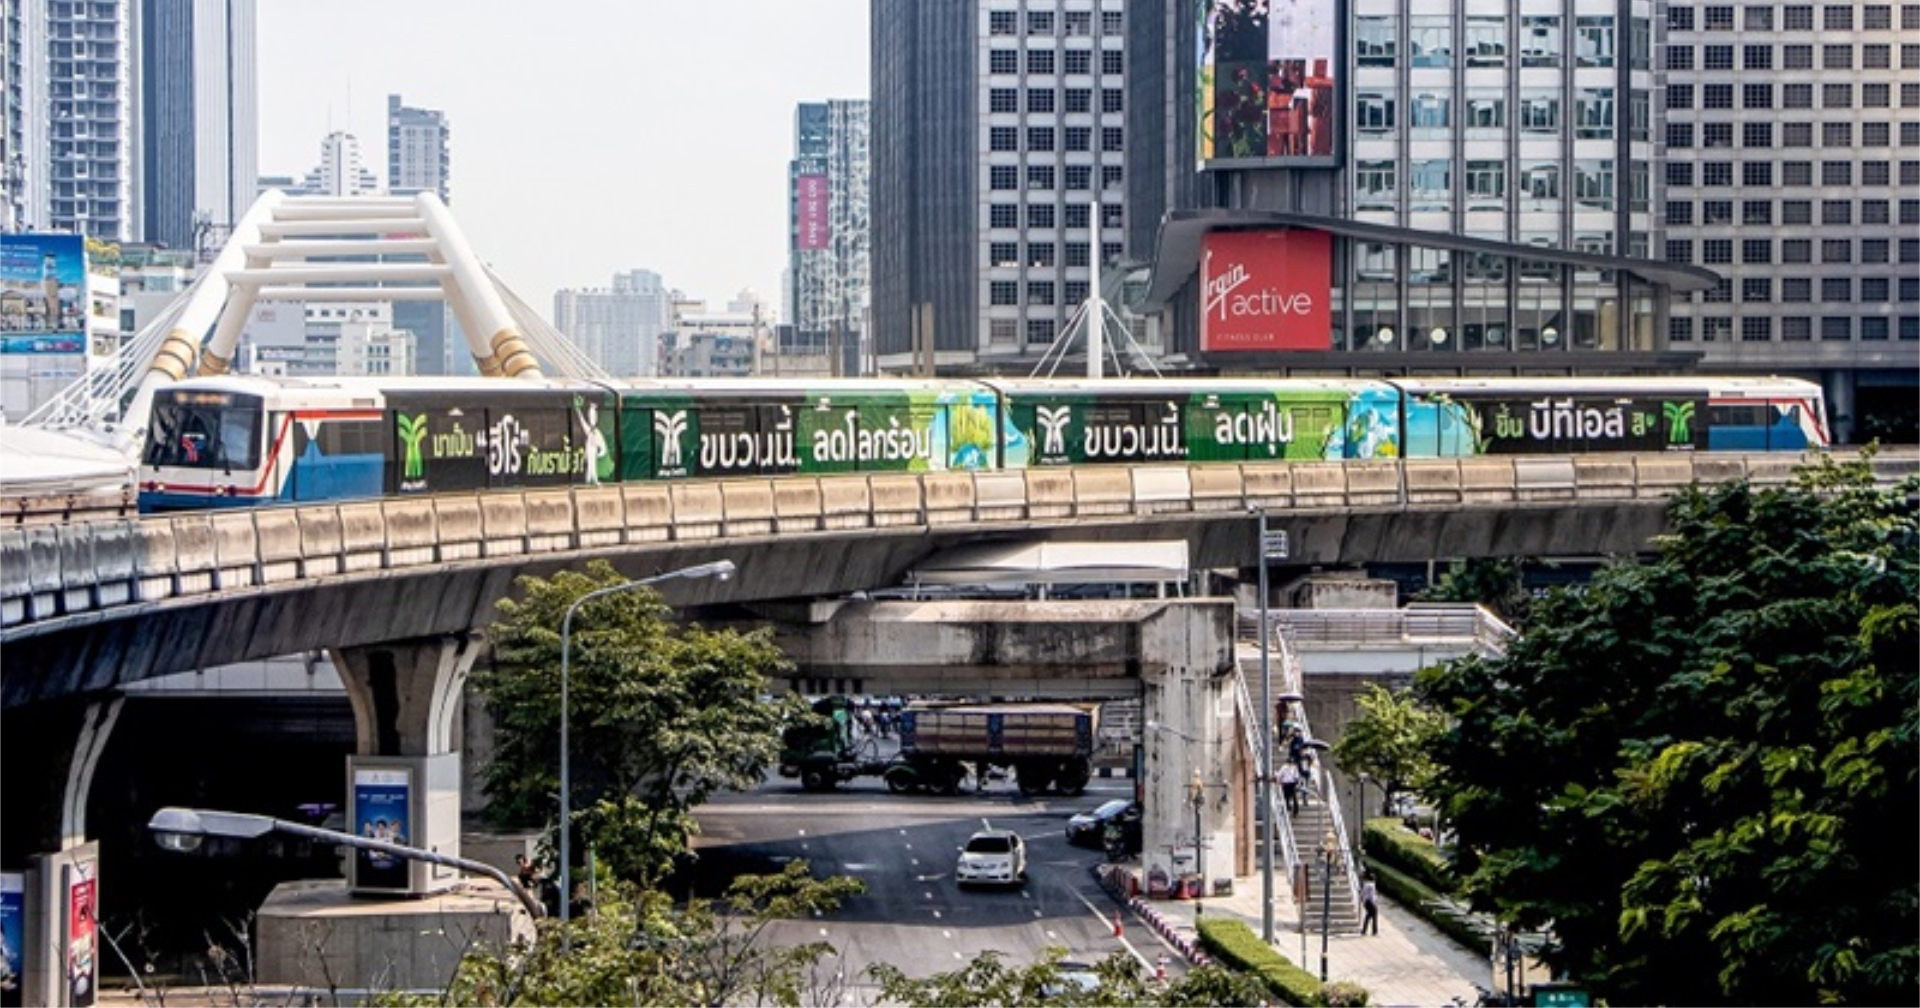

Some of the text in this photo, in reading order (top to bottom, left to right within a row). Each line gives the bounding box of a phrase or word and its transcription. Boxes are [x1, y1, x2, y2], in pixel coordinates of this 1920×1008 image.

[1231, 288, 1311, 315] active
[813, 410, 930, 462] ลดโลกร้อน
[1214, 399, 1293, 455] ลดฝุ่น
[1530, 397, 1624, 439] บีทีเอส
